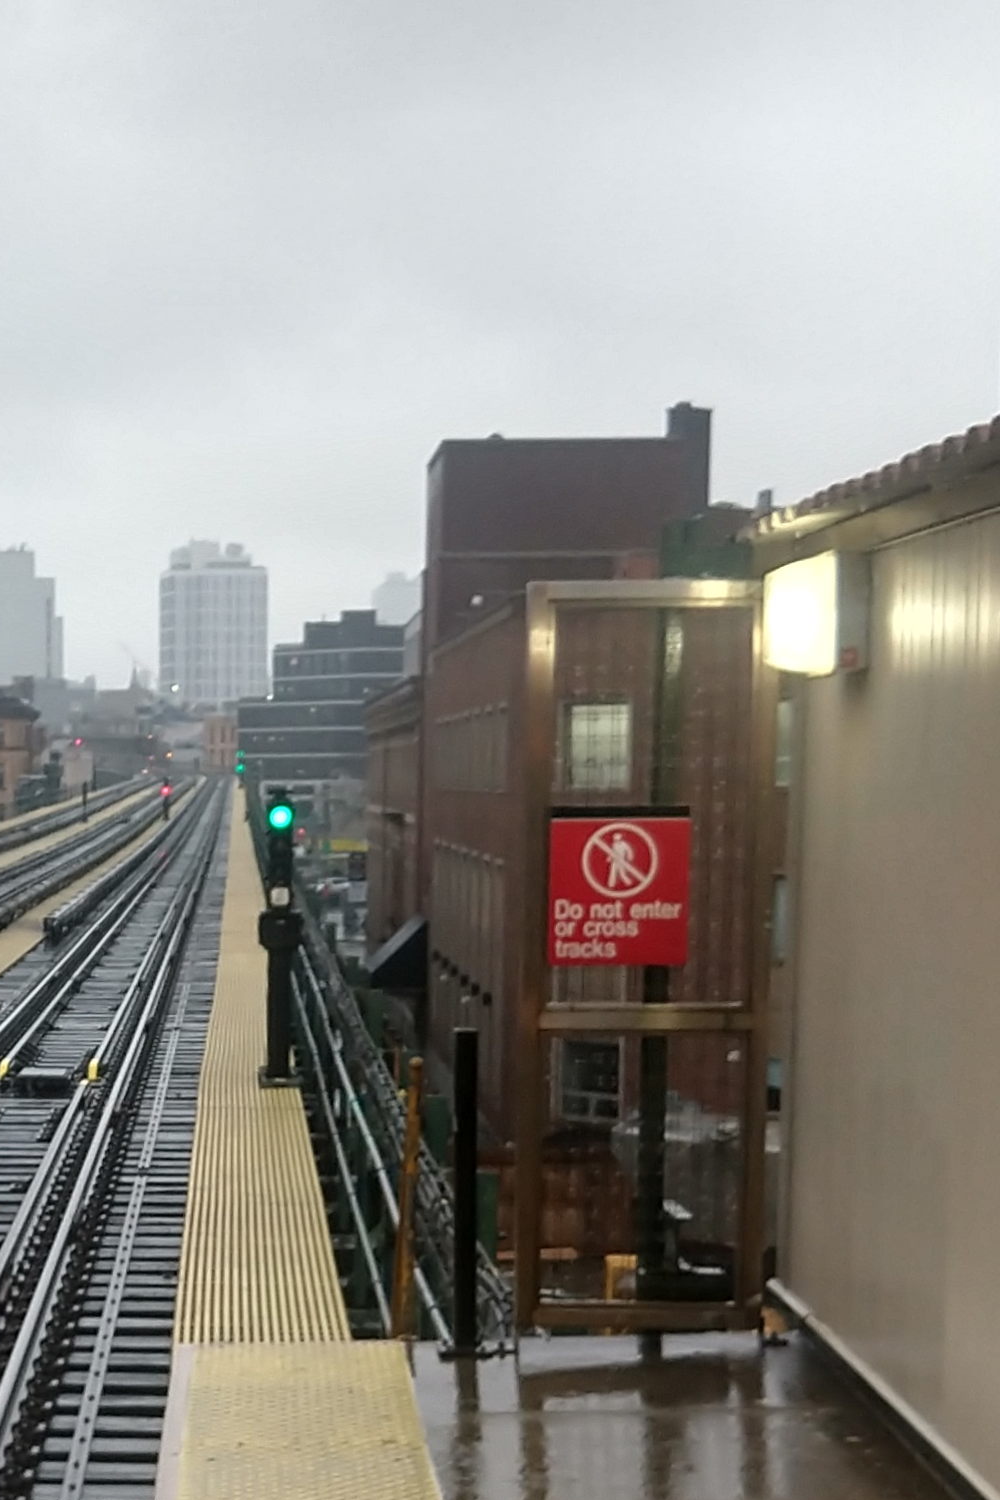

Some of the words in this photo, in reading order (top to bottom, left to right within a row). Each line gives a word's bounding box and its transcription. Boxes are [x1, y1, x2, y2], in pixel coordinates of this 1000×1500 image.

[554, 898, 584, 920] Do
[589, 900, 623, 920] not
[629, 900, 682, 920] enter
[554, 919, 577, 937] or
[582, 919, 640, 938] cross
[554, 938, 617, 959] tracks
